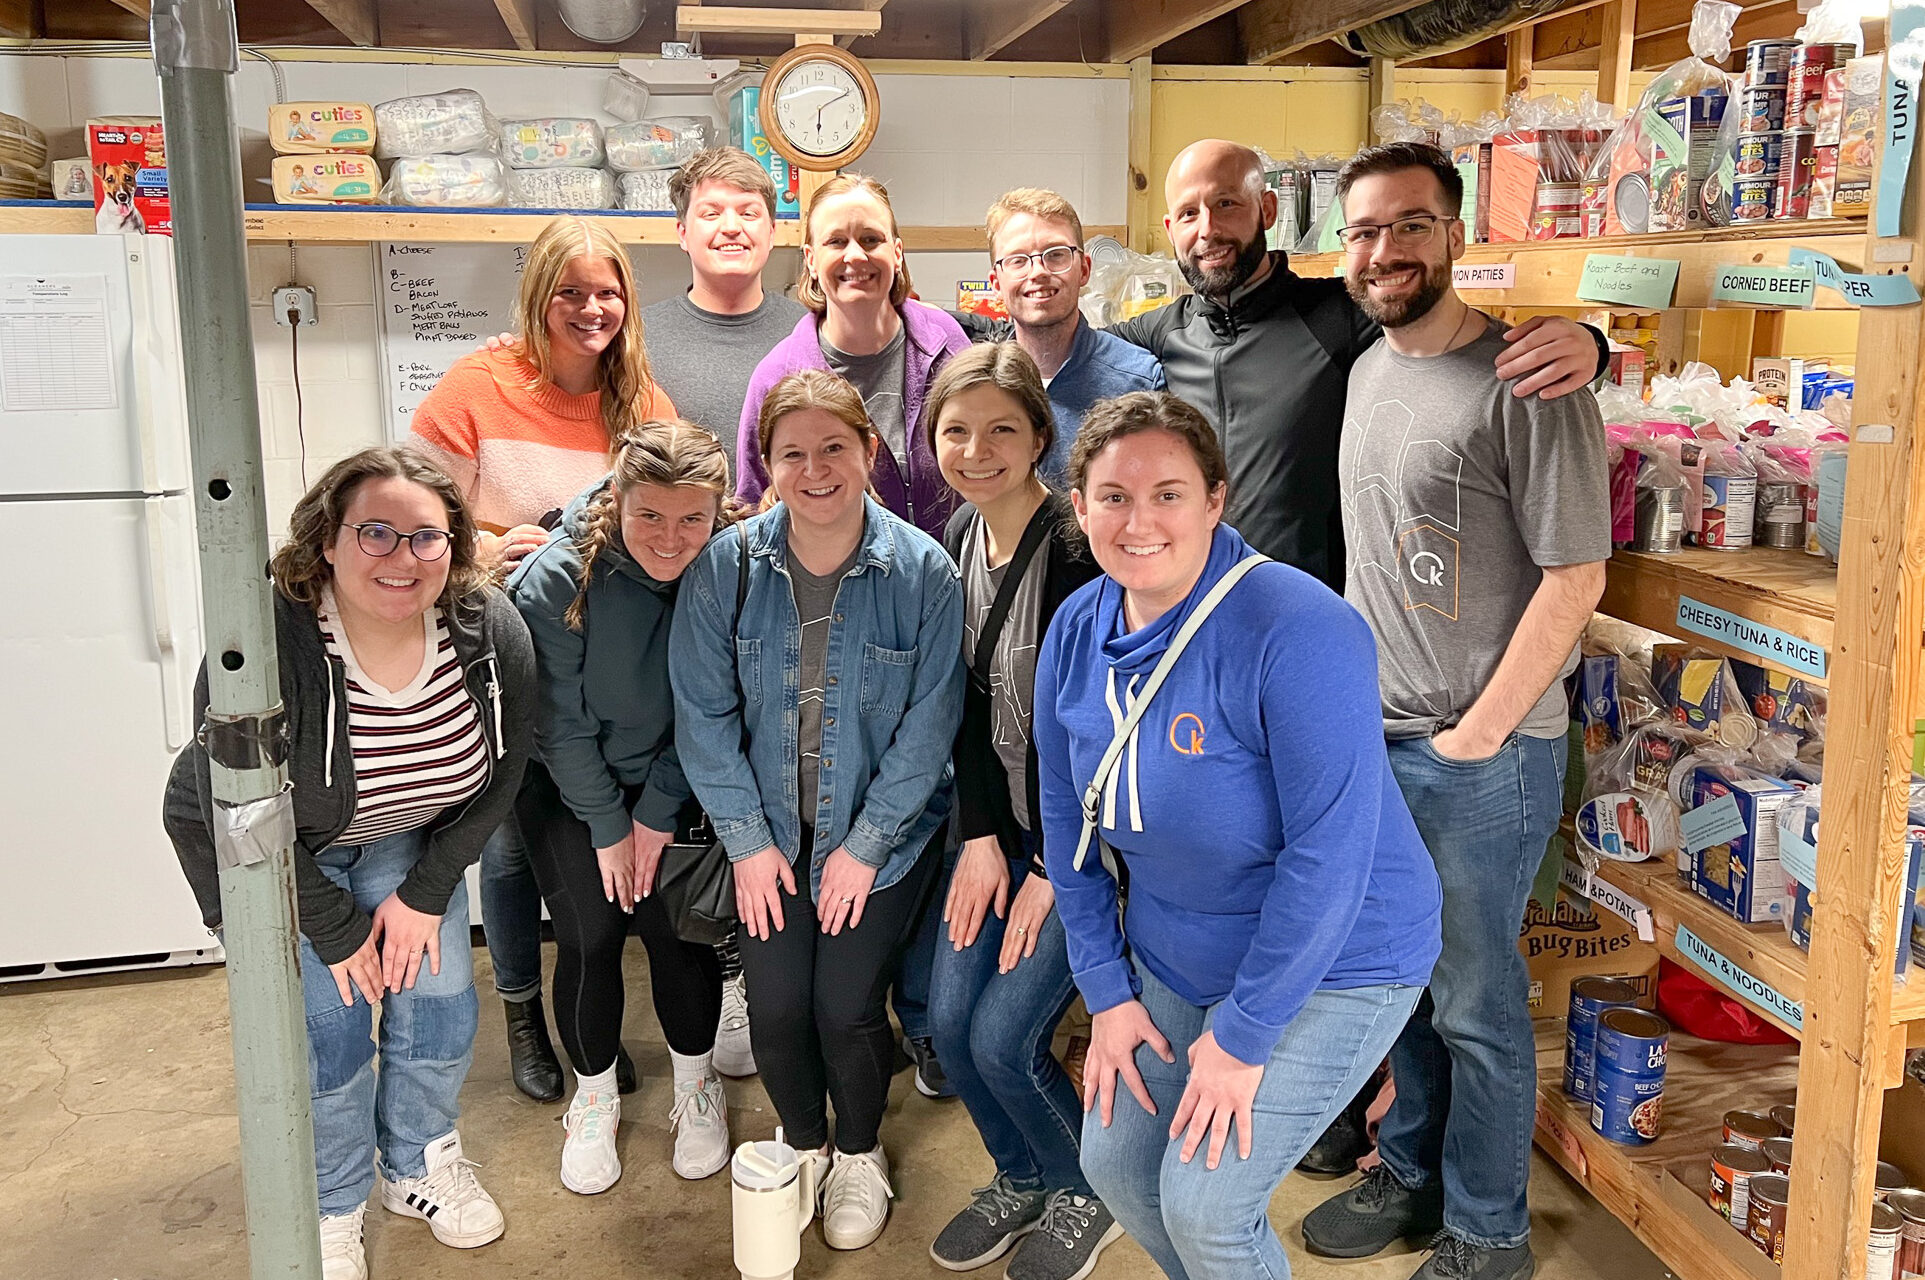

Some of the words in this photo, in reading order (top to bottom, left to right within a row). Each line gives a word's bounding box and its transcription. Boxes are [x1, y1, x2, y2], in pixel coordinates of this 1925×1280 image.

[801, 74, 809, 85] 11
[814, 70, 824, 81] 12
[783, 103, 790, 113] 9
[848, 103, 855, 113] 3
[1891, 78, 1909, 147] TUNA
[311, 106, 363, 122] cuties
[789, 119, 796, 129] 8
[843, 119, 849, 130] 4
[803, 131, 809, 142] 7
[816, 136, 824, 145] 6
[832, 131, 839, 142] 5
[1741, 147, 1764, 156] BITES
[313, 160, 365, 176] cuties
[1739, 182, 1771, 190] ARMOUR
[1741, 192, 1767, 201] BITES
[1472, 268, 1504, 281] PATTIES
[1587, 260, 1611, 273] Roast
[1614, 262, 1637, 274] Beef
[1641, 264, 1661, 278] and
[962, 281, 984, 290] TWIN
[1595, 279, 1633, 290] Noodles
[1721, 275, 1766, 291] CORNED
[1769, 277, 1812, 294] BEEF
[409, 289, 439, 301] BACON
[413, 321, 437, 331] MEAT
[415, 332, 444, 342] PLANT
[445, 332, 477, 342] BASED
[1758, 368, 1786, 382] PROTEIN
[1679, 604, 1731, 633] CHEESY
[1733, 622, 1769, 648] TUNA
[1773, 636, 1783, 653] &
[1786, 641, 1819, 666] RICE
[1565, 868, 1587, 892] HAM
[1528, 934, 1573, 958] Bug
[1575, 933, 1631, 958] Bites
[1686, 932, 1718, 968] TUNA
[1721, 960, 1730, 975] &
[1732, 967, 1802, 1022] NOODLES
[1648, 1044, 1662, 1058] LA
[1634, 1083, 1649, 1091] BEEF
